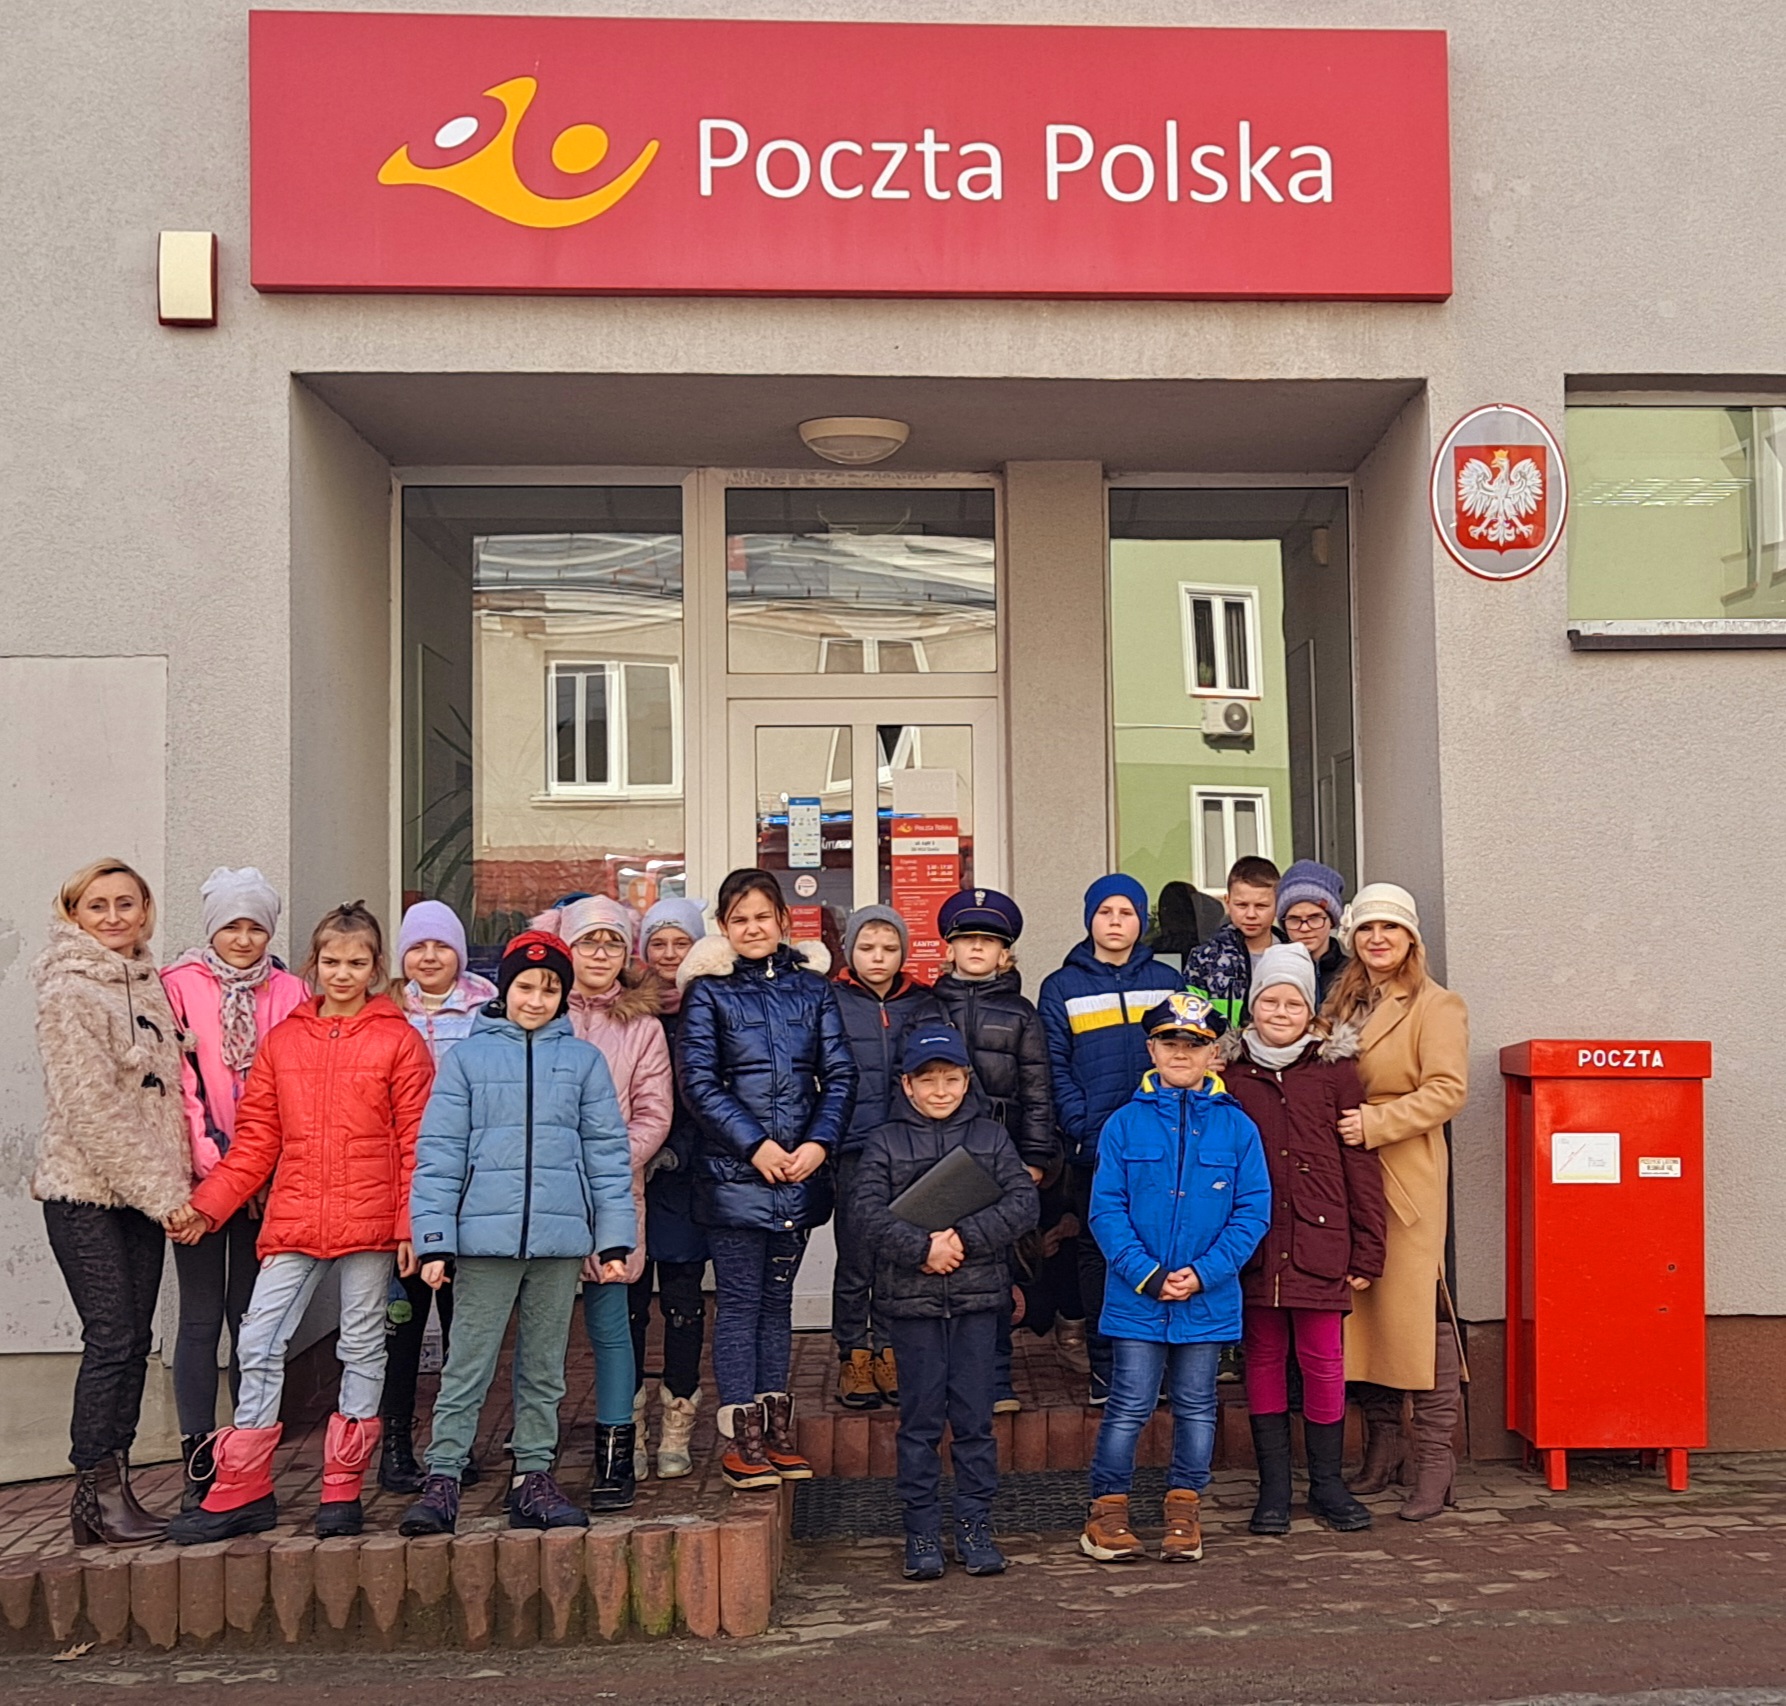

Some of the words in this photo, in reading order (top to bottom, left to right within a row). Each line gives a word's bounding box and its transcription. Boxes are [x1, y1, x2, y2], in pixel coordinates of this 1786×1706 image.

[699, 118, 1003, 201] Poczta
[1045, 119, 1333, 204] Polska
[1578, 1049, 1664, 1068] POCZTA
